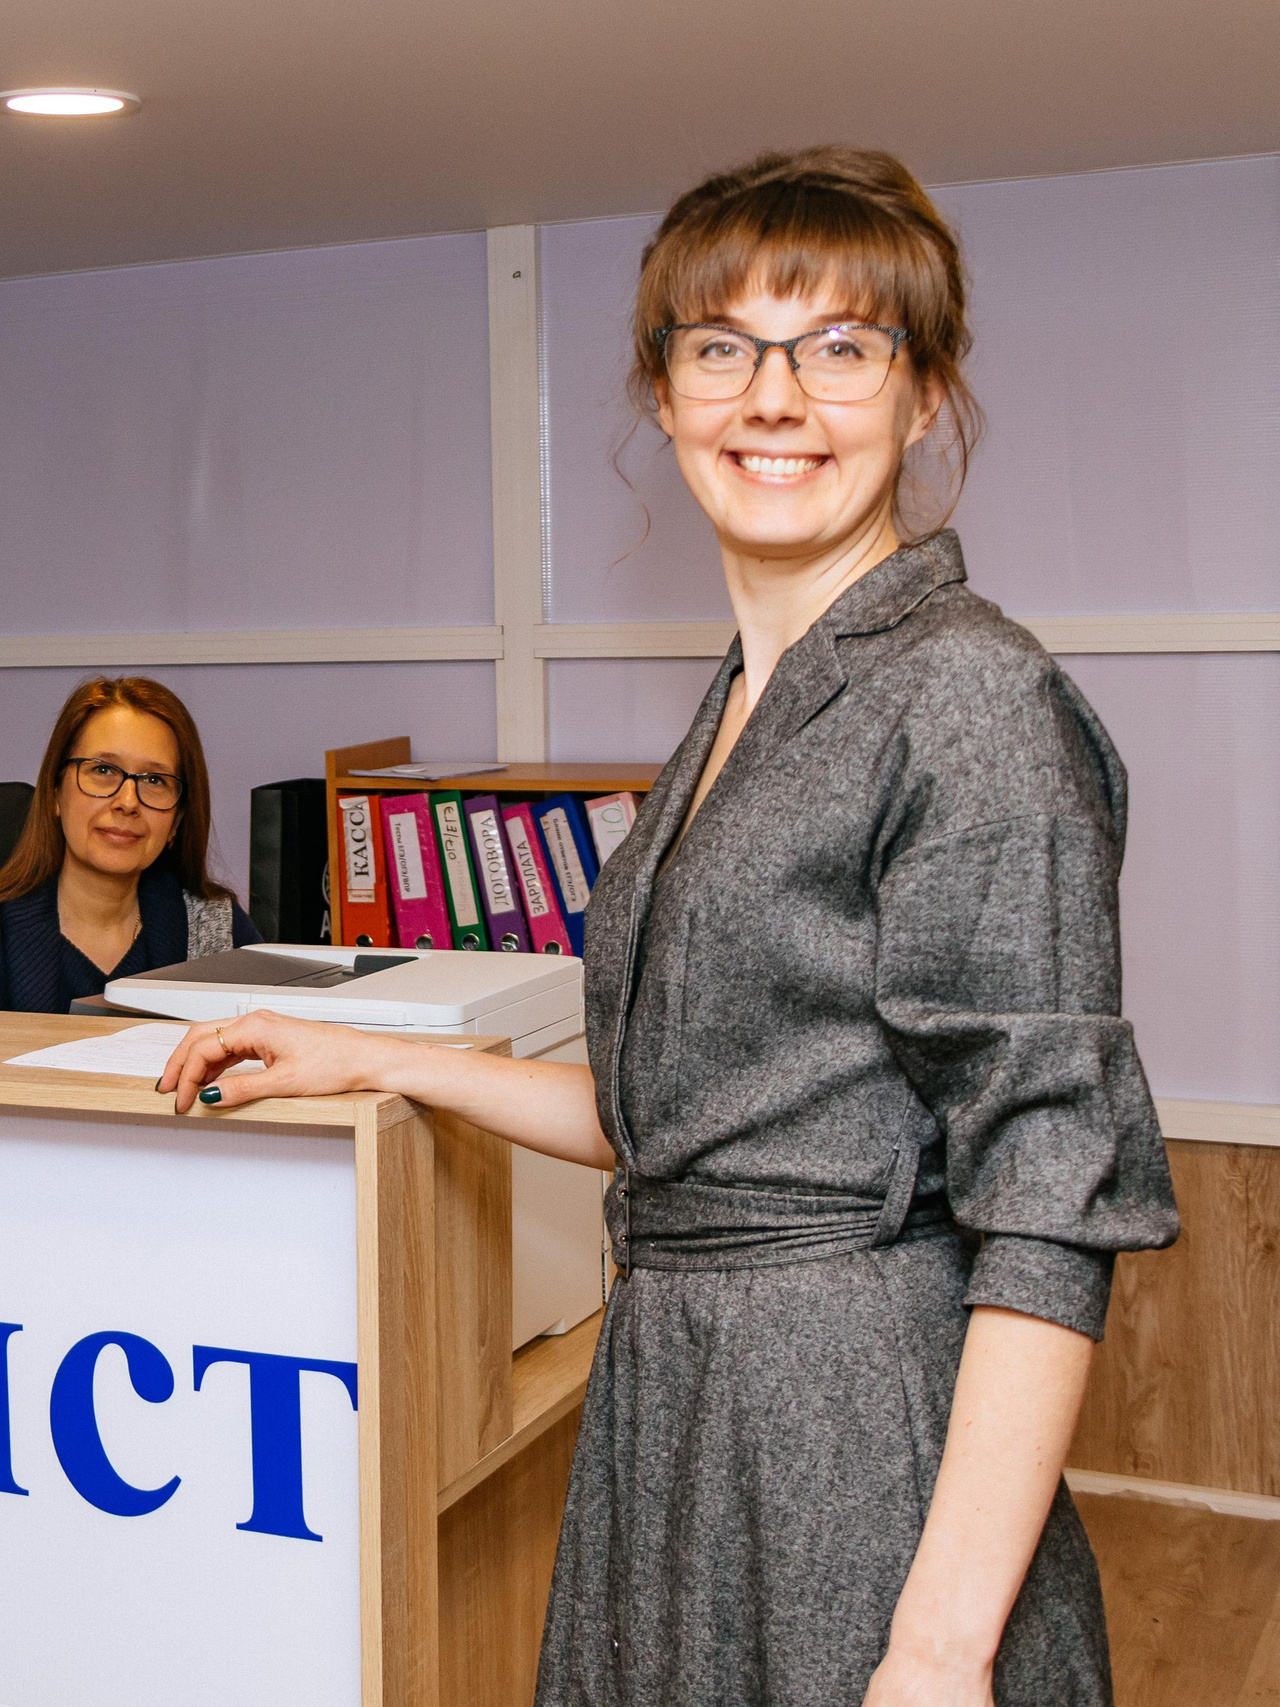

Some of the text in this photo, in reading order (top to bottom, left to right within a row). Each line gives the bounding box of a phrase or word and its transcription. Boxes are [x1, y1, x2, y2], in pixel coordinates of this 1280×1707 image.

[398, 844, 411, 893] ЕГЭ/ОГЭ/ВПР
[481, 817, 509, 905] ДОГОВОРА
[517, 840, 545, 914] ЗАРПЛАТА
[558, 841, 569, 871] ответов
